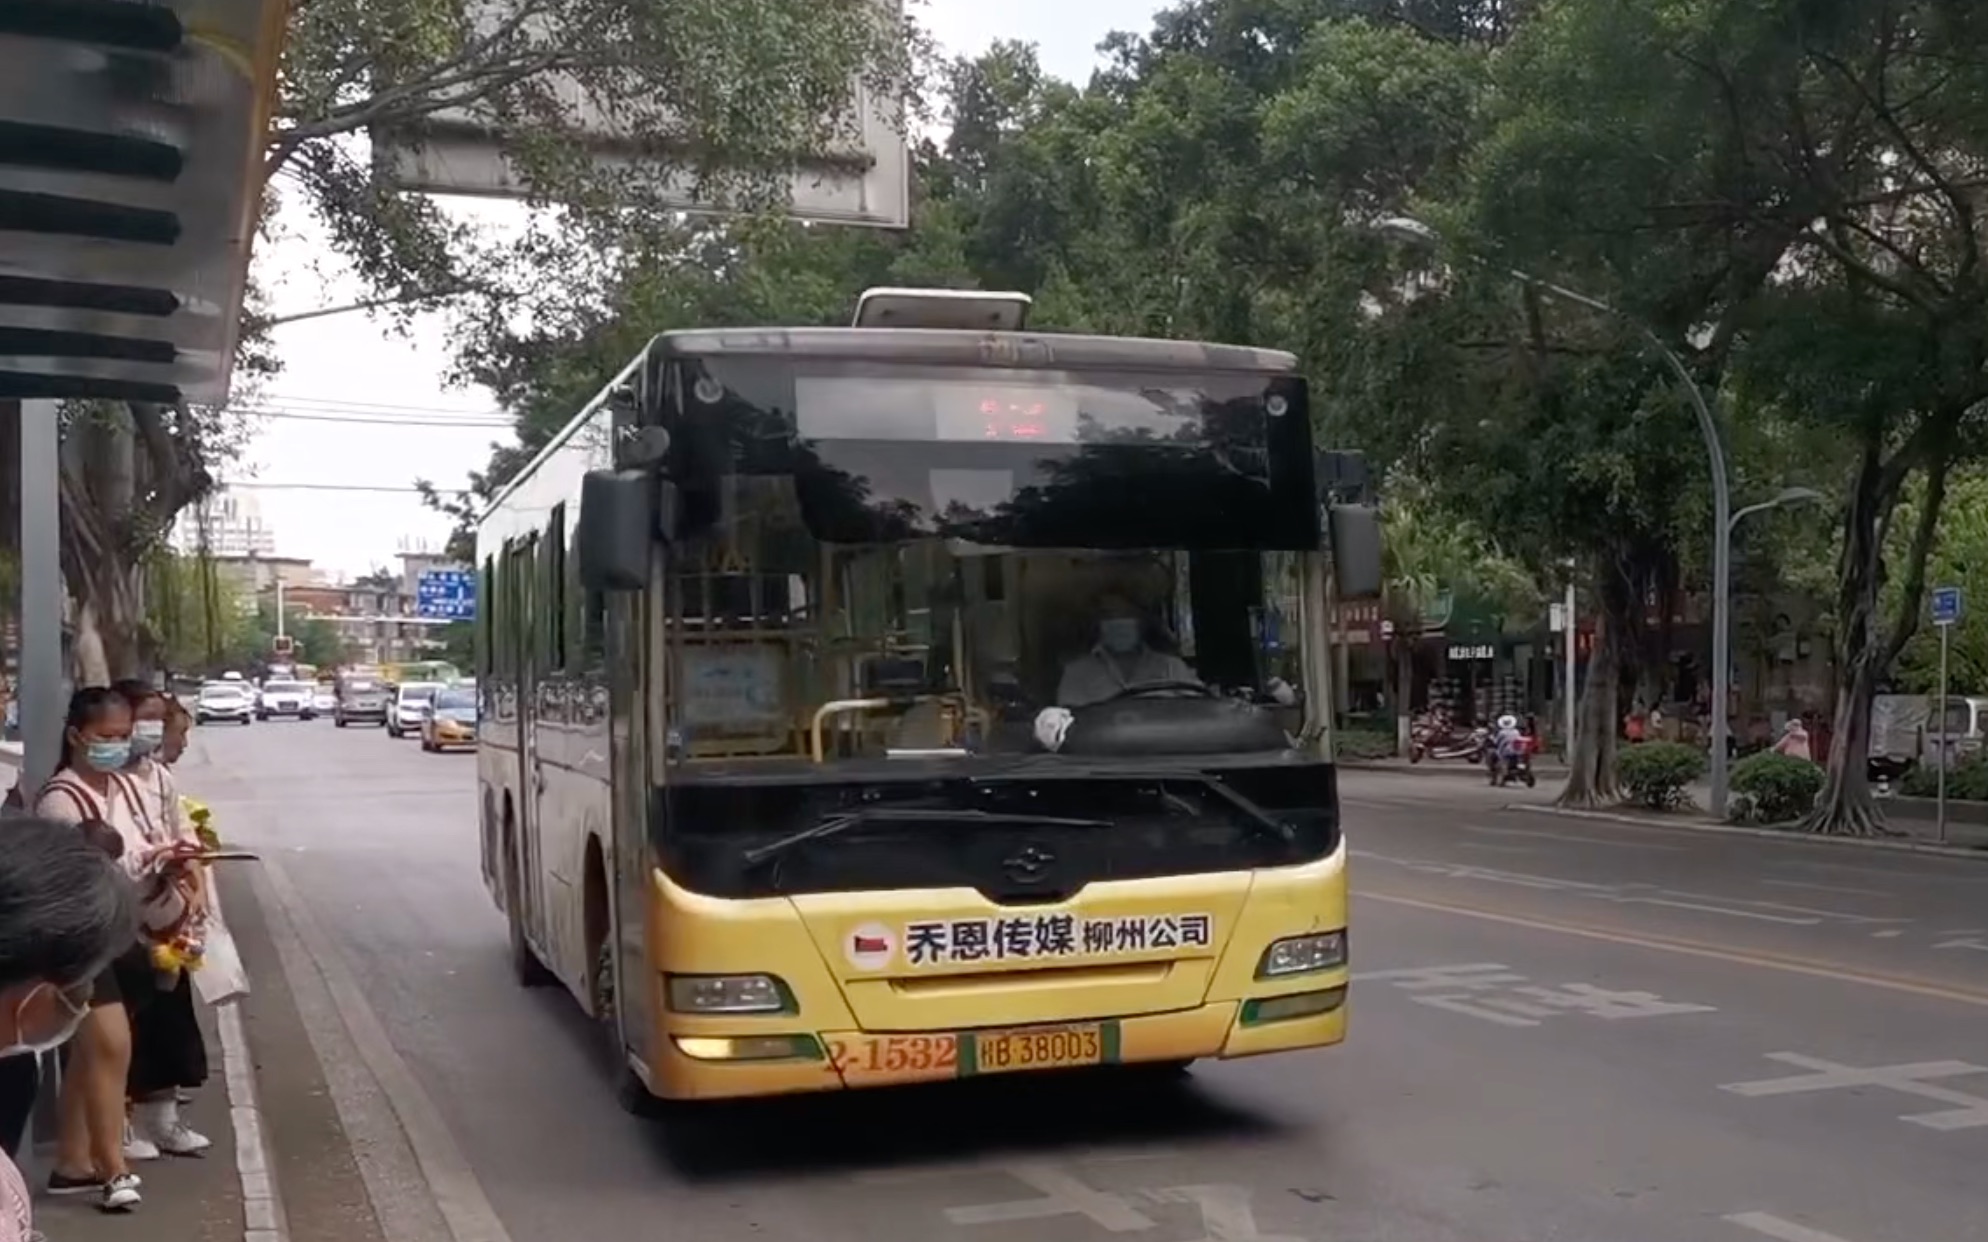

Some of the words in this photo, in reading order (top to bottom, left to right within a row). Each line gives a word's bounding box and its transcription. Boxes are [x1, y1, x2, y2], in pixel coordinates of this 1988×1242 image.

[906, 915, 1075, 964] 乔恩传媒
[1082, 916, 1209, 953] 柳州公司
[823, 1036, 956, 1073] 2-1532
